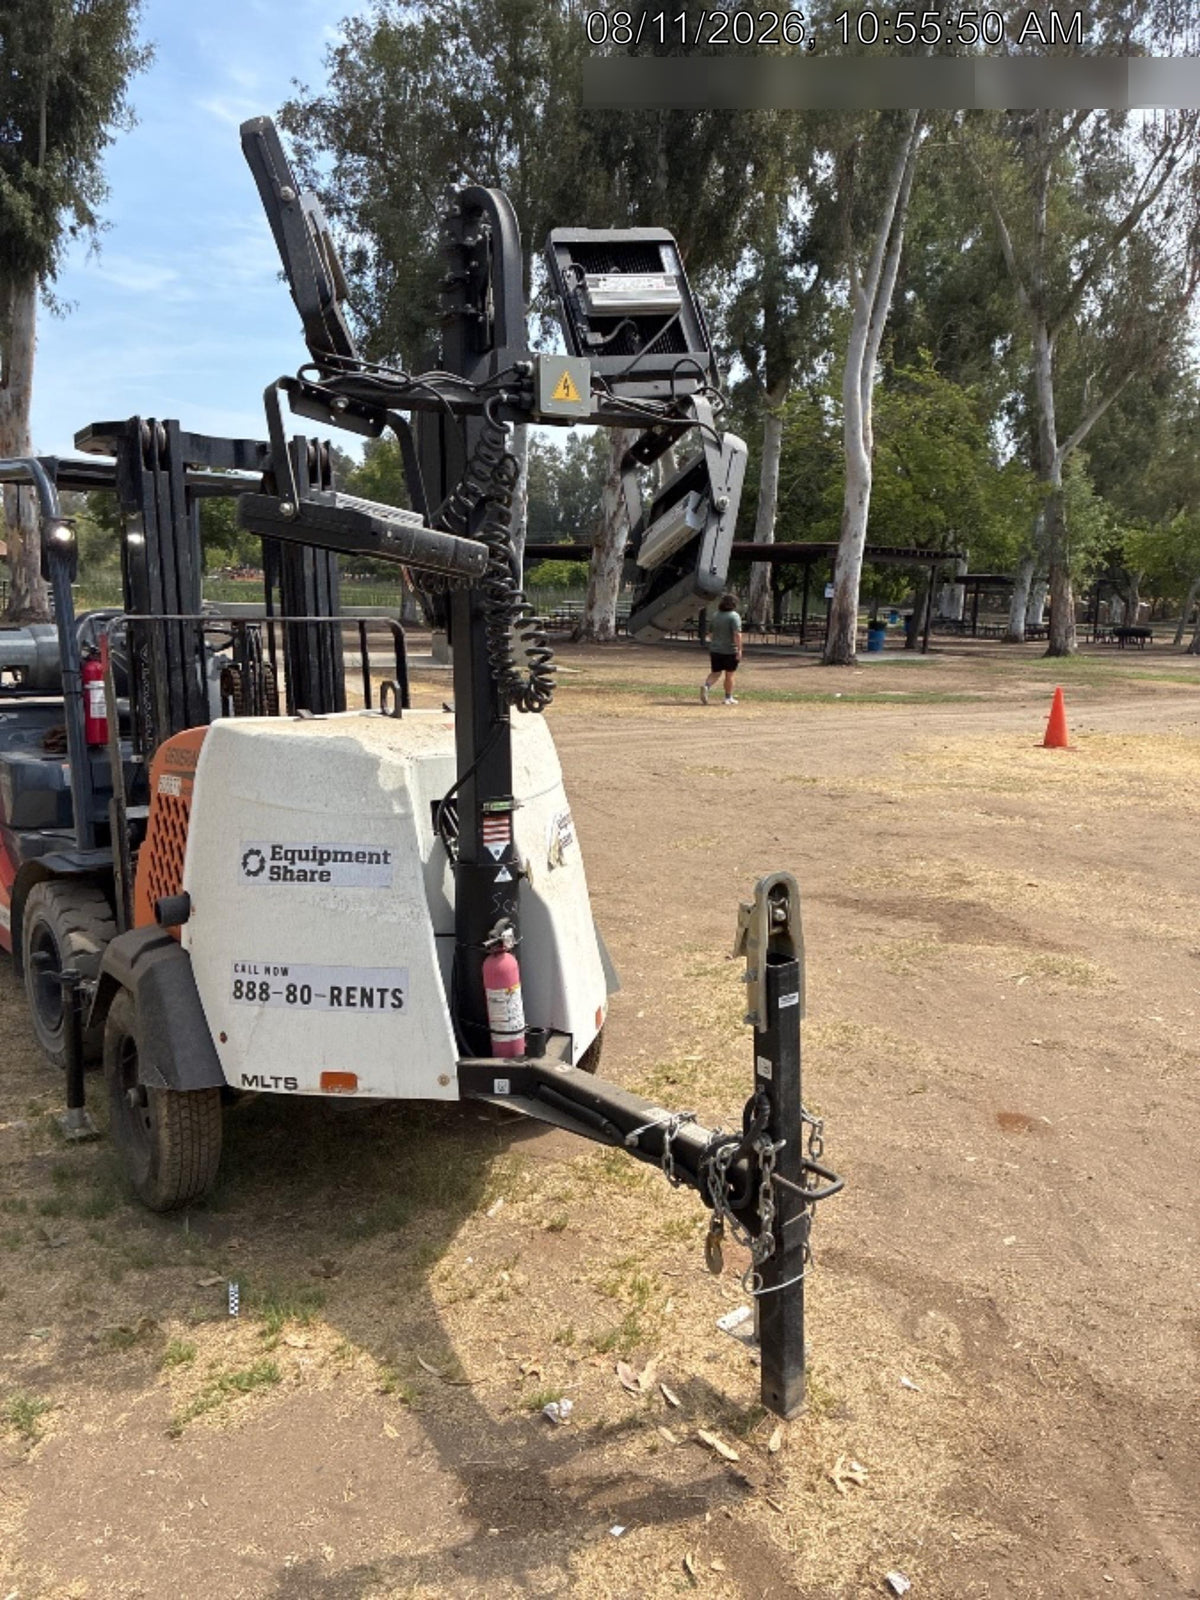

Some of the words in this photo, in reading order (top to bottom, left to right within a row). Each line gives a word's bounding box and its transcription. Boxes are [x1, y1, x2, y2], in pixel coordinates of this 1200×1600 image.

[269, 844, 392, 866] Equipment
[268, 865, 332, 883] Share
[233, 963, 260, 976] CALL
[264, 965, 290, 977] NOW
[232, 978, 404, 1010] 888-80-RENTS
[241, 1073, 299, 1091] MLTS
